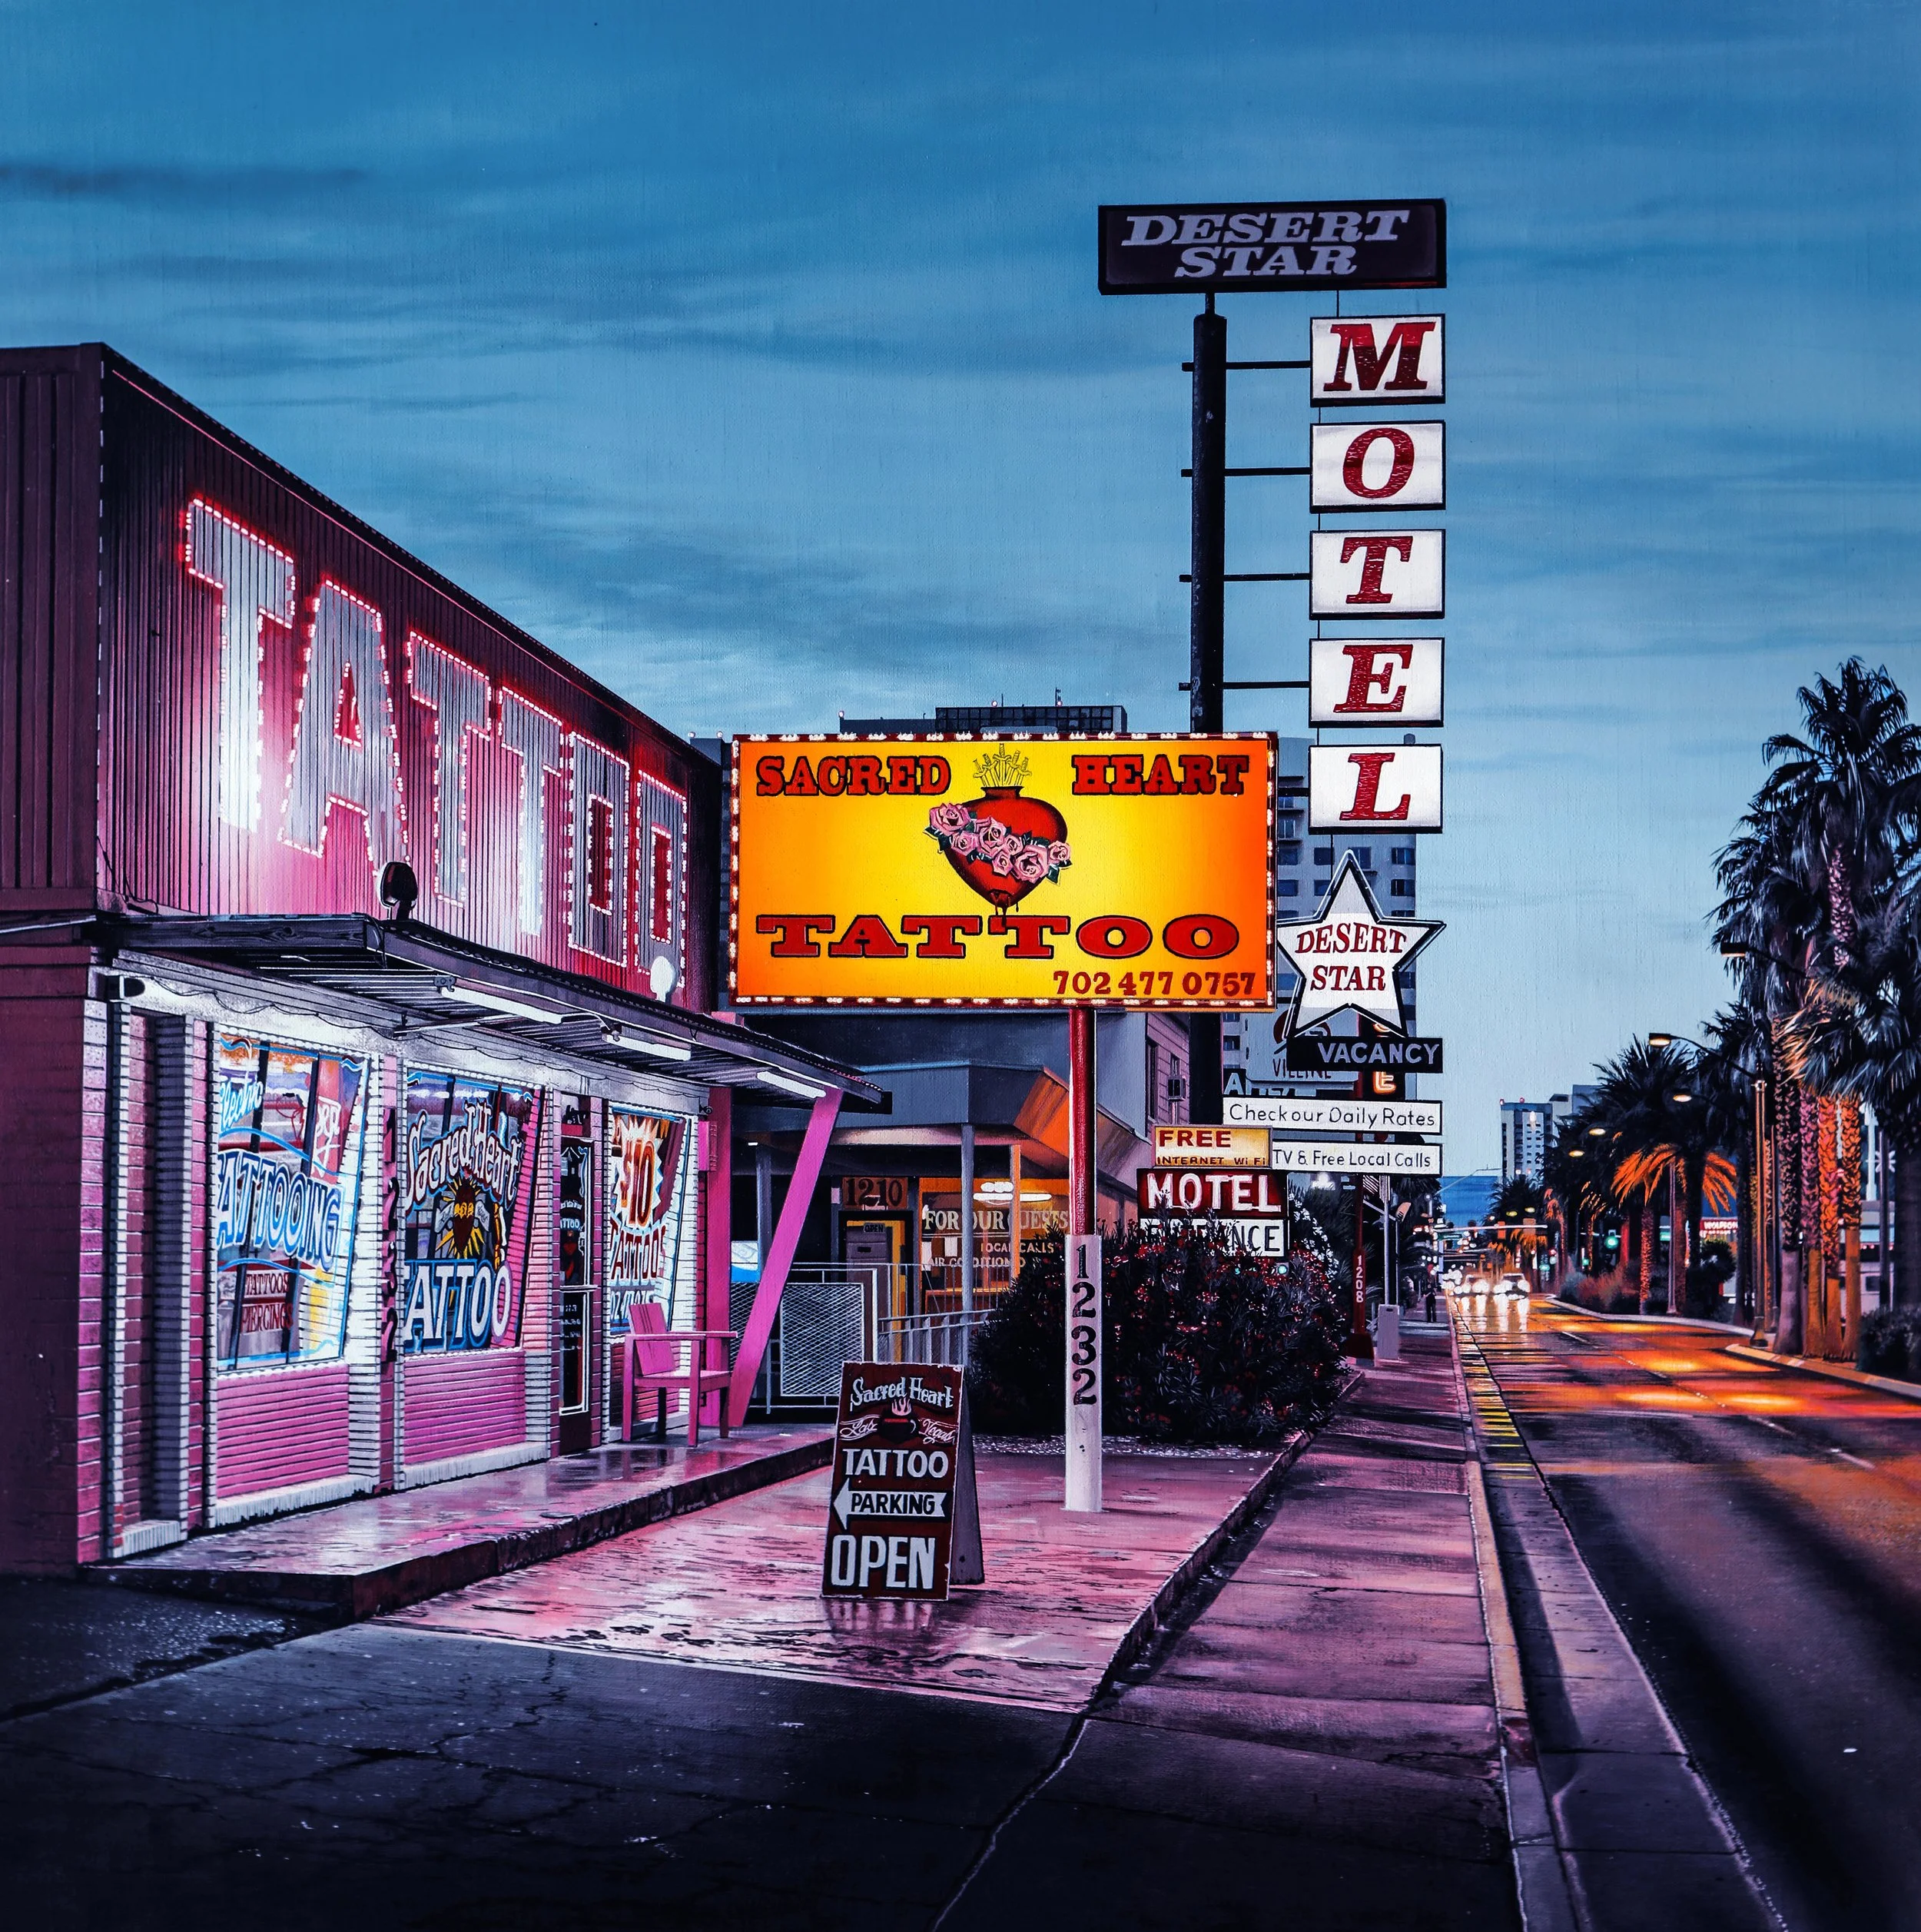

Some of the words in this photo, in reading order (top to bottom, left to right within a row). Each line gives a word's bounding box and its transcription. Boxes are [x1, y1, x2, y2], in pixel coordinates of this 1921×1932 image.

[1121, 210, 1410, 246] DESERT
[1174, 245, 1358, 278] STAR
[1323, 321, 1436, 822] MOTEL
[185, 498, 688, 988] TATTOO
[756, 755, 952, 796] SACRED
[1071, 755, 1250, 795] HEART
[756, 914, 1240, 960] TATTOO
[1295, 921, 1407, 954] DESERT
[1053, 971, 1112, 995] 702
[1118, 971, 1174, 996] 477
[1182, 971, 1256, 997] 0757
[1309, 965, 1386, 992] STAR
[1318, 1042, 1440, 1065] VACANCY
[1329, 1107, 1377, 1129] Daily
[1382, 1107, 1435, 1127] Rates
[1159, 1130, 1231, 1147] FREE
[405, 1101, 476, 1211] Sacred
[474, 1101, 523, 1201] Heart
[1156, 1157, 1225, 1165] INTERNET
[1272, 1149, 1292, 1165] TV
[1298, 1150, 1308, 1167] &
[1312, 1150, 1345, 1167] Free
[1349, 1151, 1391, 1167] Local
[1395, 1152, 1431, 1169] Calls
[845, 1178, 903, 1207] 1210
[1146, 1172, 1282, 1213] MOTEL
[924, 1210, 960, 1230] FOR
[1007, 1210, 1069, 1230] UESTS
[927, 1256, 945, 1267] AIR
[244, 1272, 290, 1296] TATTOOS
[1355, 1254, 1364, 1303] 1208
[240, 1303, 294, 1335] PIERCINGS
[1070, 1243, 1097, 1406] 1232
[850, 1376, 907, 1412] Sacred
[909, 1376, 954, 1409] Heart
[842, 1448, 949, 1479] TATTOO
[850, 1492, 936, 1515] PARKING
[831, 1534, 936, 1590] OPEN
